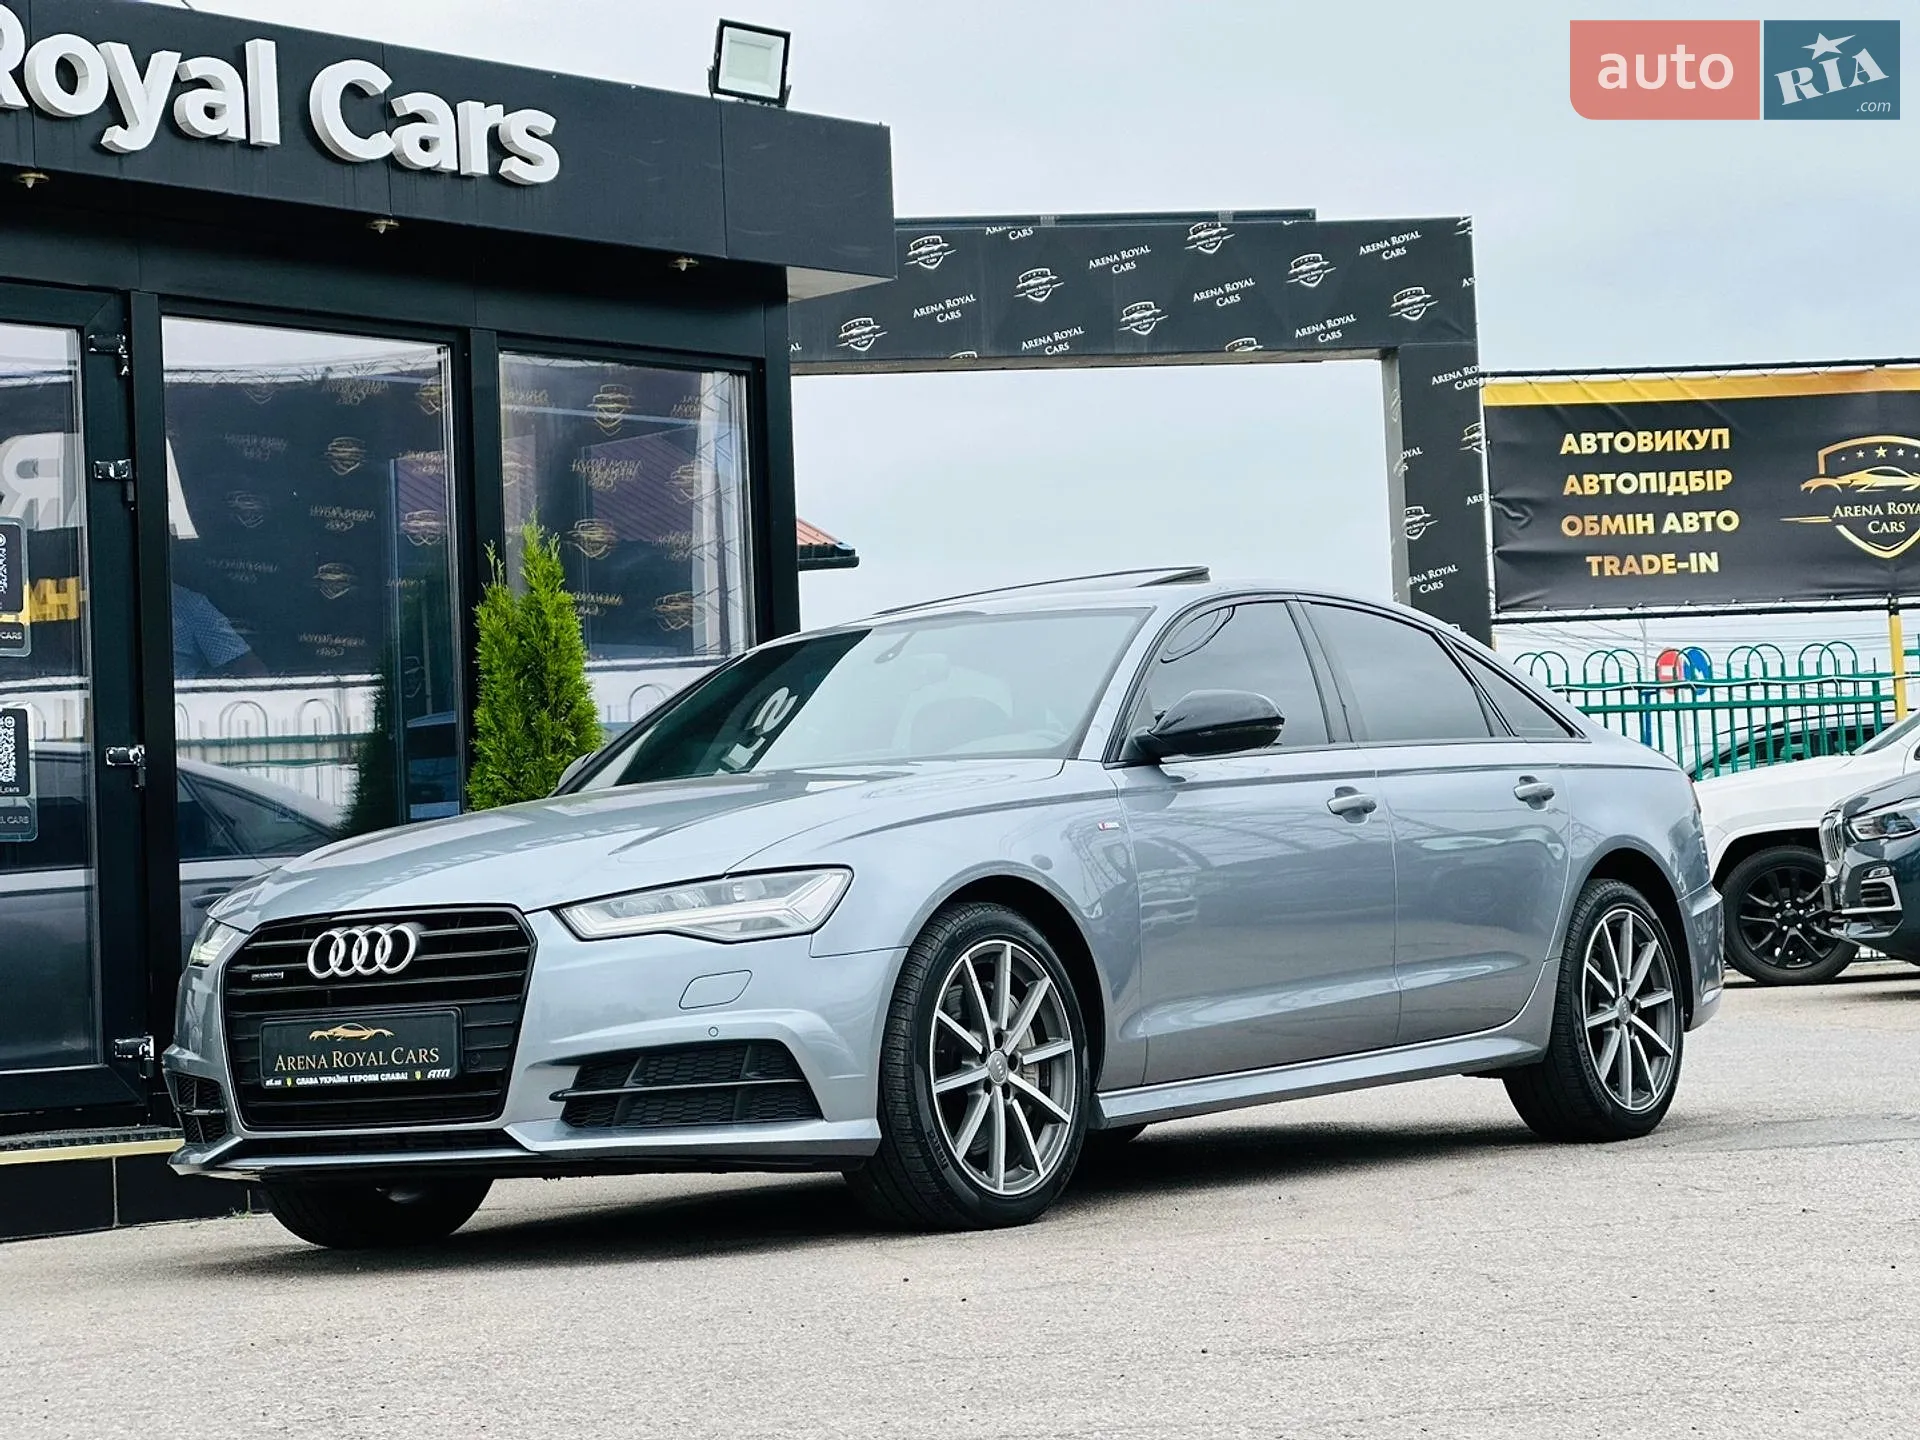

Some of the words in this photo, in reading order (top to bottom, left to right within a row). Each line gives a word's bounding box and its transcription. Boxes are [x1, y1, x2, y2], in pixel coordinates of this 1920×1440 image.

[309, 58, 560, 186] Cars
[1359, 240, 1390, 256] ARENA
[1390, 230, 1423, 246] ROYAL
[1382, 245, 1407, 260] CARS
[1088, 254, 1120, 270] ARENA
[1120, 244, 1152, 260] ROYAL
[1112, 260, 1137, 274] CARS
[1193, 286, 1225, 303] ARENA
[1224, 277, 1256, 293] ROYAL
[1216, 293, 1241, 307] CARS
[913, 302, 945, 319] ARENA
[945, 293, 977, 310] ROYAL
[936, 309, 962, 323] CARS
[1021, 335, 1054, 351] ARENA
[1053, 325, 1086, 341] ROYAL
[1295, 322, 1326, 339] ARENA
[1326, 313, 1357, 329] ROYAL
[1318, 329, 1343, 343] CARS
[1045, 341, 1070, 355] CARS
[1431, 370, 1463, 386] ARENA
[1560, 428, 1730, 455] АВТОВИКУП
[1563, 469, 1733, 496] АВТОПІДБІР
[1832, 504, 1884, 518] ARENA
[1561, 512, 1655, 538] ОБМІН
[1662, 510, 1740, 534] АВТО
[1867, 520, 1906, 534] CARS
[1427, 564, 1459, 579] ROYAL
[1586, 552, 1719, 577] TRADE-IN
[1419, 580, 1444, 594] CARS
[274, 1053, 328, 1072] ARENA
[332, 1050, 388, 1068] ROYAL
[391, 1046, 440, 1065] CARS
